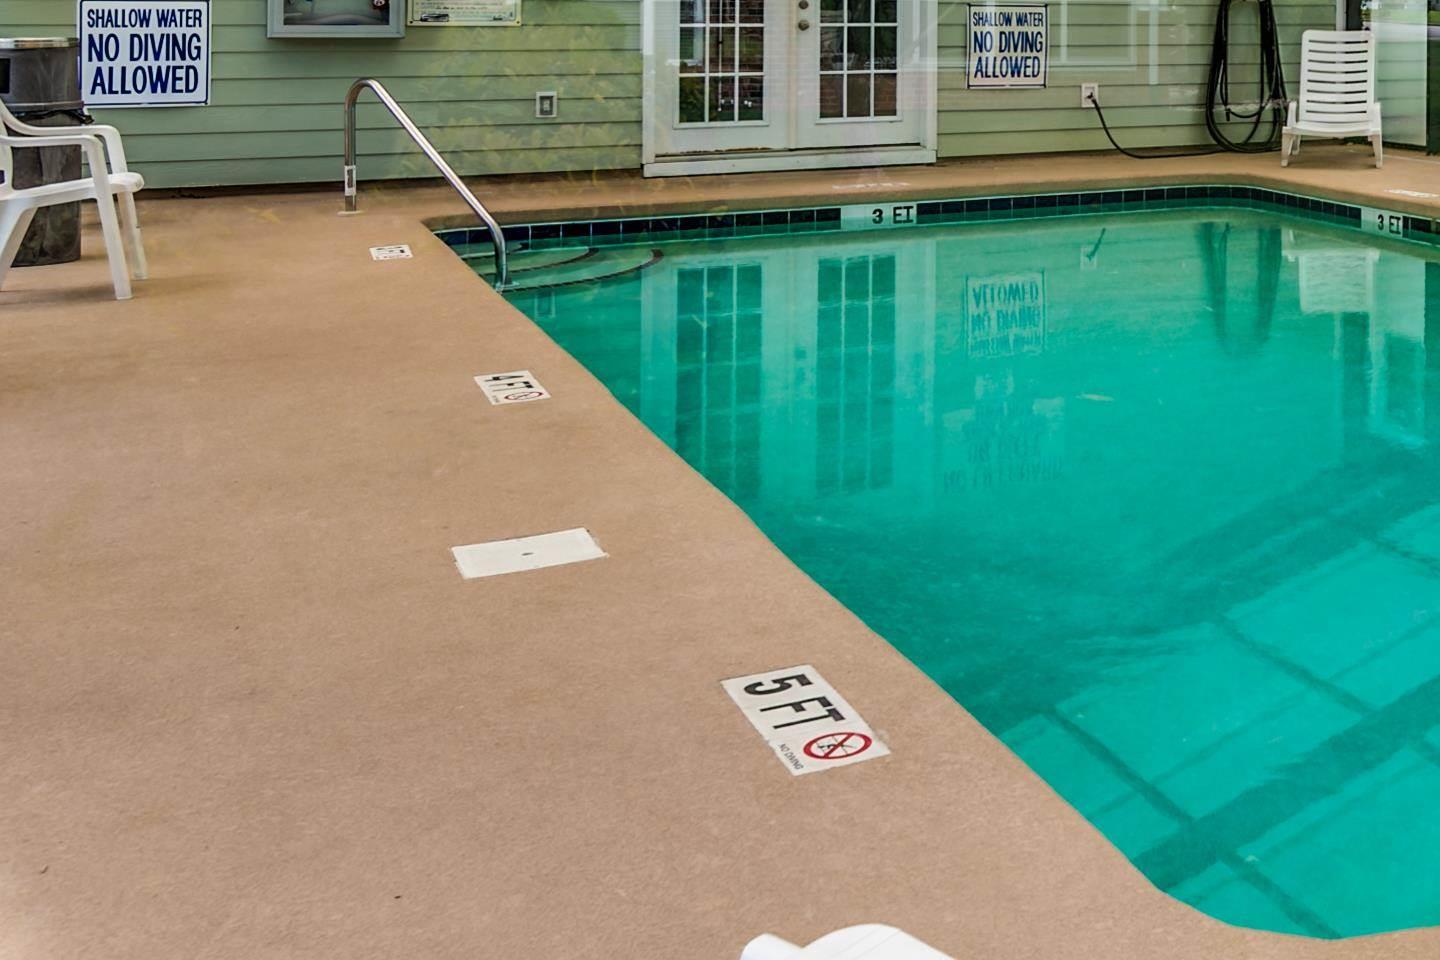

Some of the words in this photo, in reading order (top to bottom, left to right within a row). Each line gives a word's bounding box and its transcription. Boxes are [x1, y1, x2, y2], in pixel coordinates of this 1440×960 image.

[87, 8, 152, 28] SHALLOW
[157, 8, 203, 28] WATER
[973, 12, 1012, 27] SHALLOW
[1015, 12, 1044, 27] WATER
[88, 33, 120, 62] NO
[130, 33, 201, 62] DIVING
[973, 31, 993, 53] NO
[999, 30, 1043, 53] DIVING
[974, 55, 1041, 78] ALLOWED
[90, 65, 199, 95] ALLOWED
[872, 208, 883, 221] 3
[743, 673, 814, 696] 5
[759, 696, 846, 730] FT
